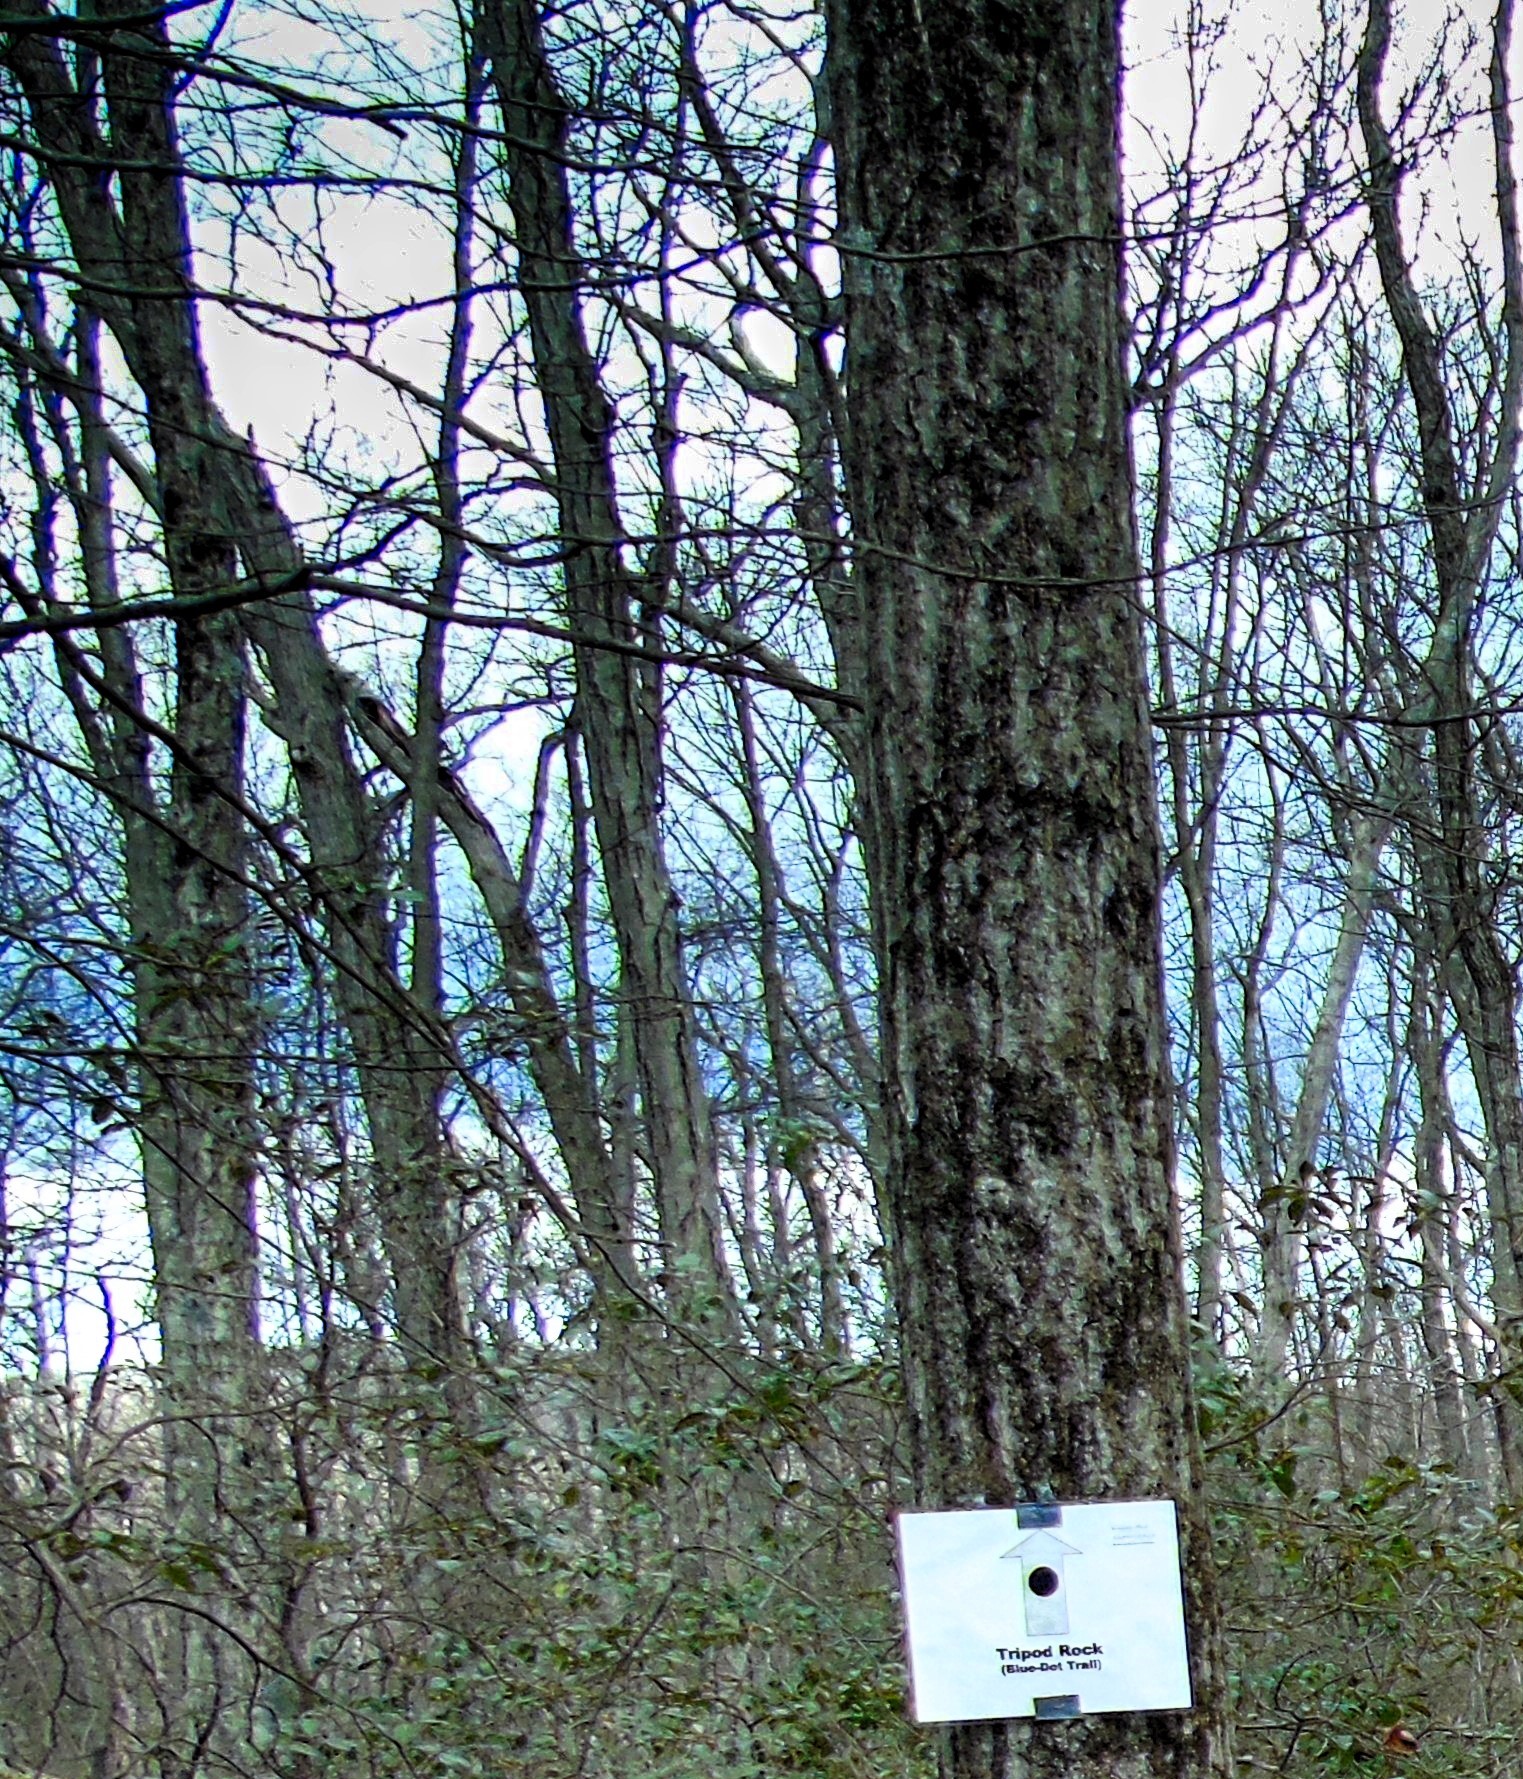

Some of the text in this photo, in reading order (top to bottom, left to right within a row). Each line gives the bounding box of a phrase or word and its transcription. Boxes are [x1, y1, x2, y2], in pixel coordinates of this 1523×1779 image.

[996, 1642, 1104, 1662] Tripod Rock
[1001, 1659, 1102, 1677] (Blue-Dot Trail)
